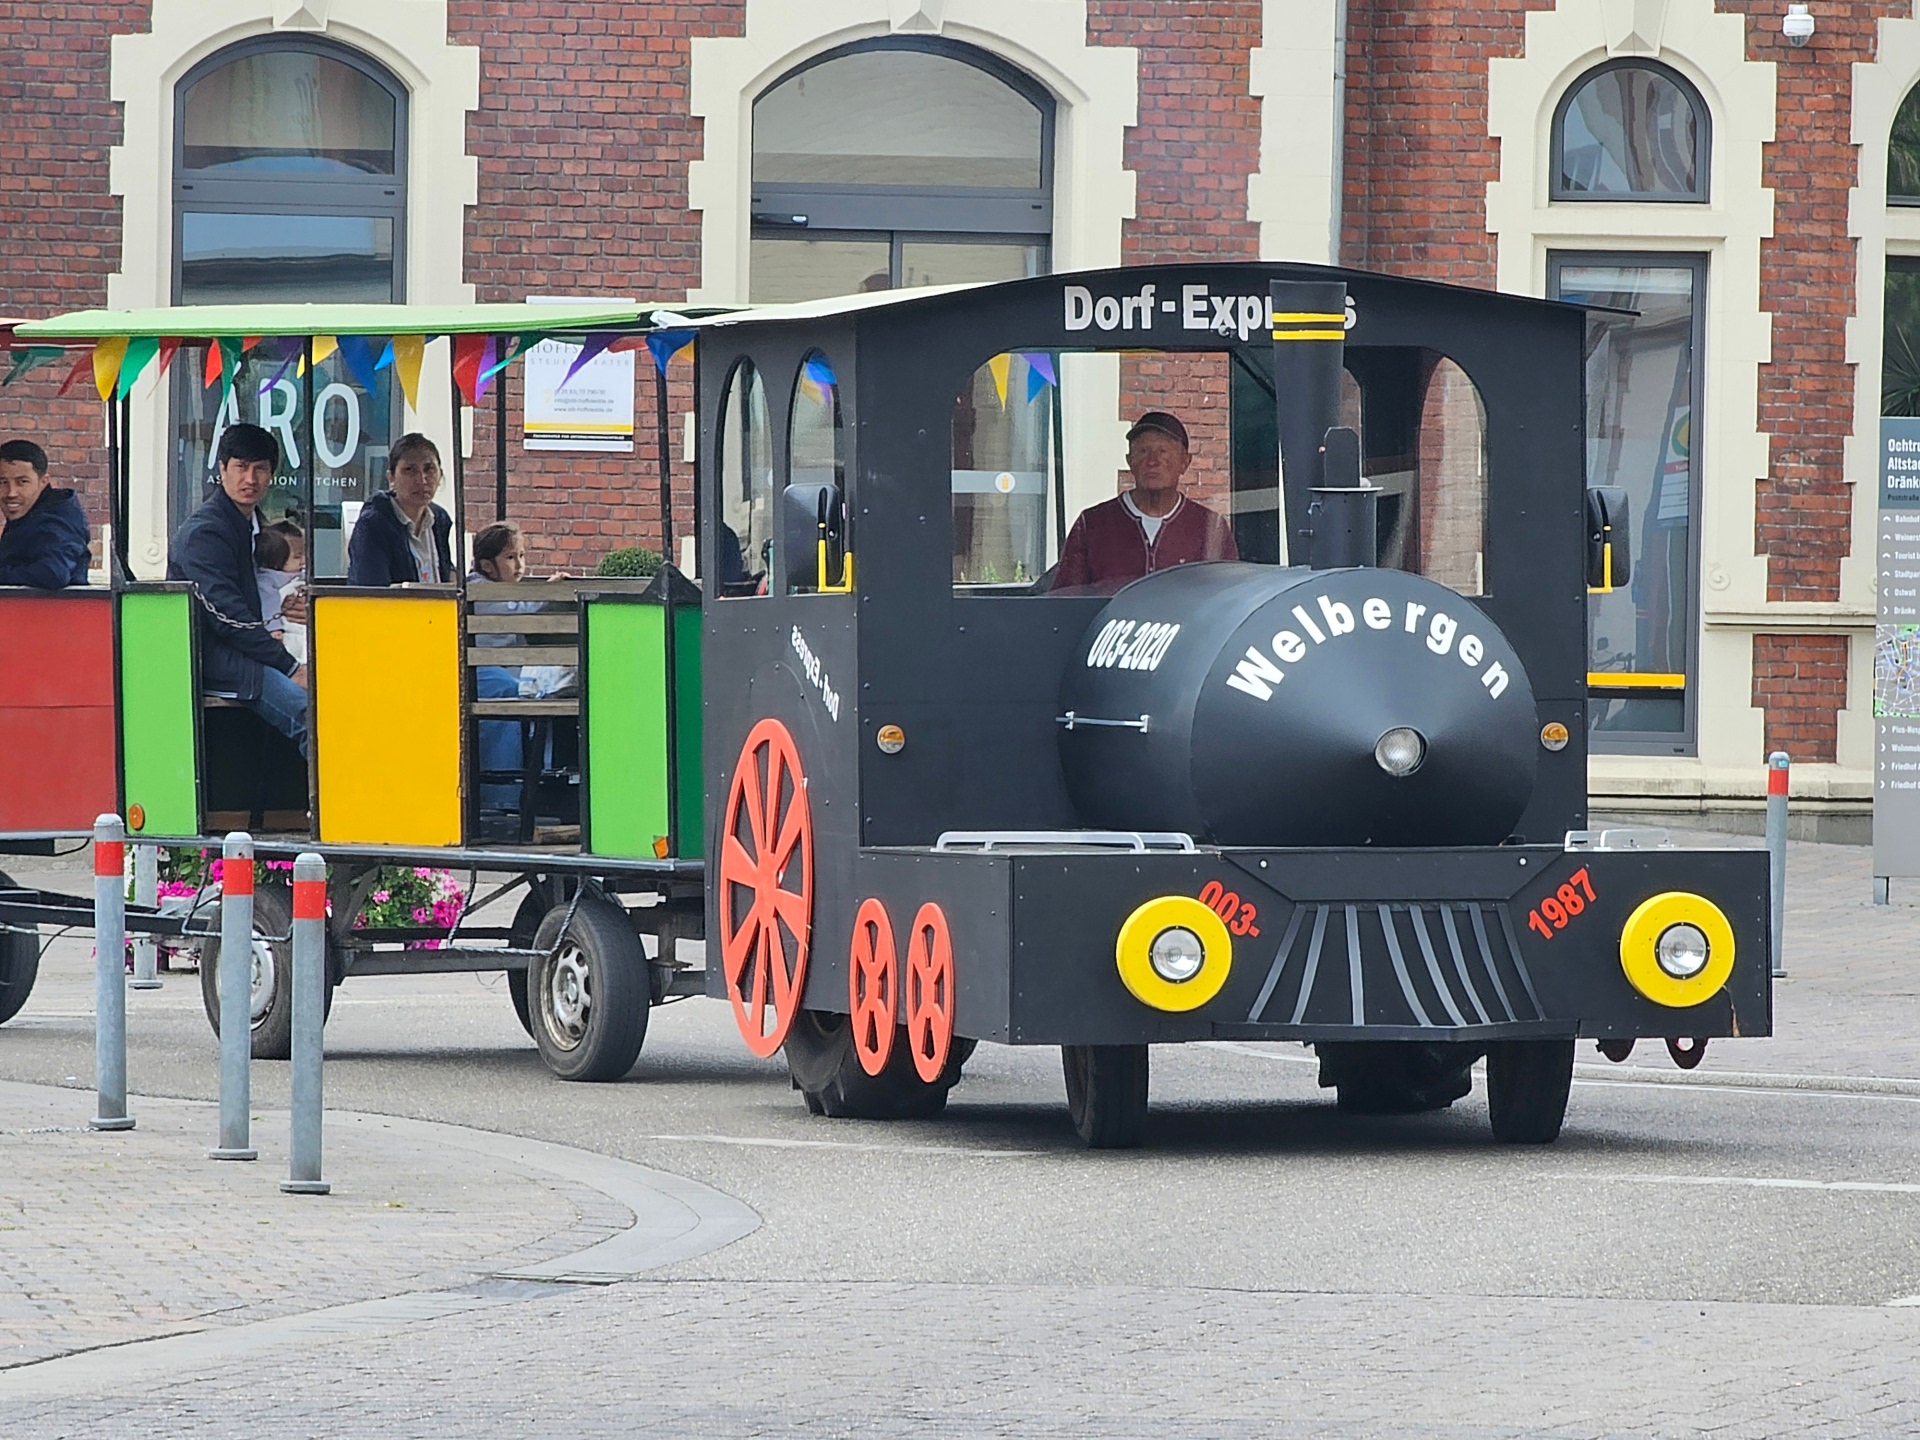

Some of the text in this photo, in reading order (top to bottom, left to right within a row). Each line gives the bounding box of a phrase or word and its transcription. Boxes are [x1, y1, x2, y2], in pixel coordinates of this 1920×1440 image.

[1887, 474, 1920, 489] Dränk
[1894, 551, 1916, 560] Tourist
[1894, 588, 1916, 597] Ostwall
[1893, 606, 1916, 615] Dränke
[1087, 619, 1180, 672] 003-2020
[1226, 595, 1510, 702] Welbergen
[1891, 762, 1917, 771] Friedhof
[1890, 780, 1917, 789] Friedhof
[1528, 867, 1597, 940] 1987
